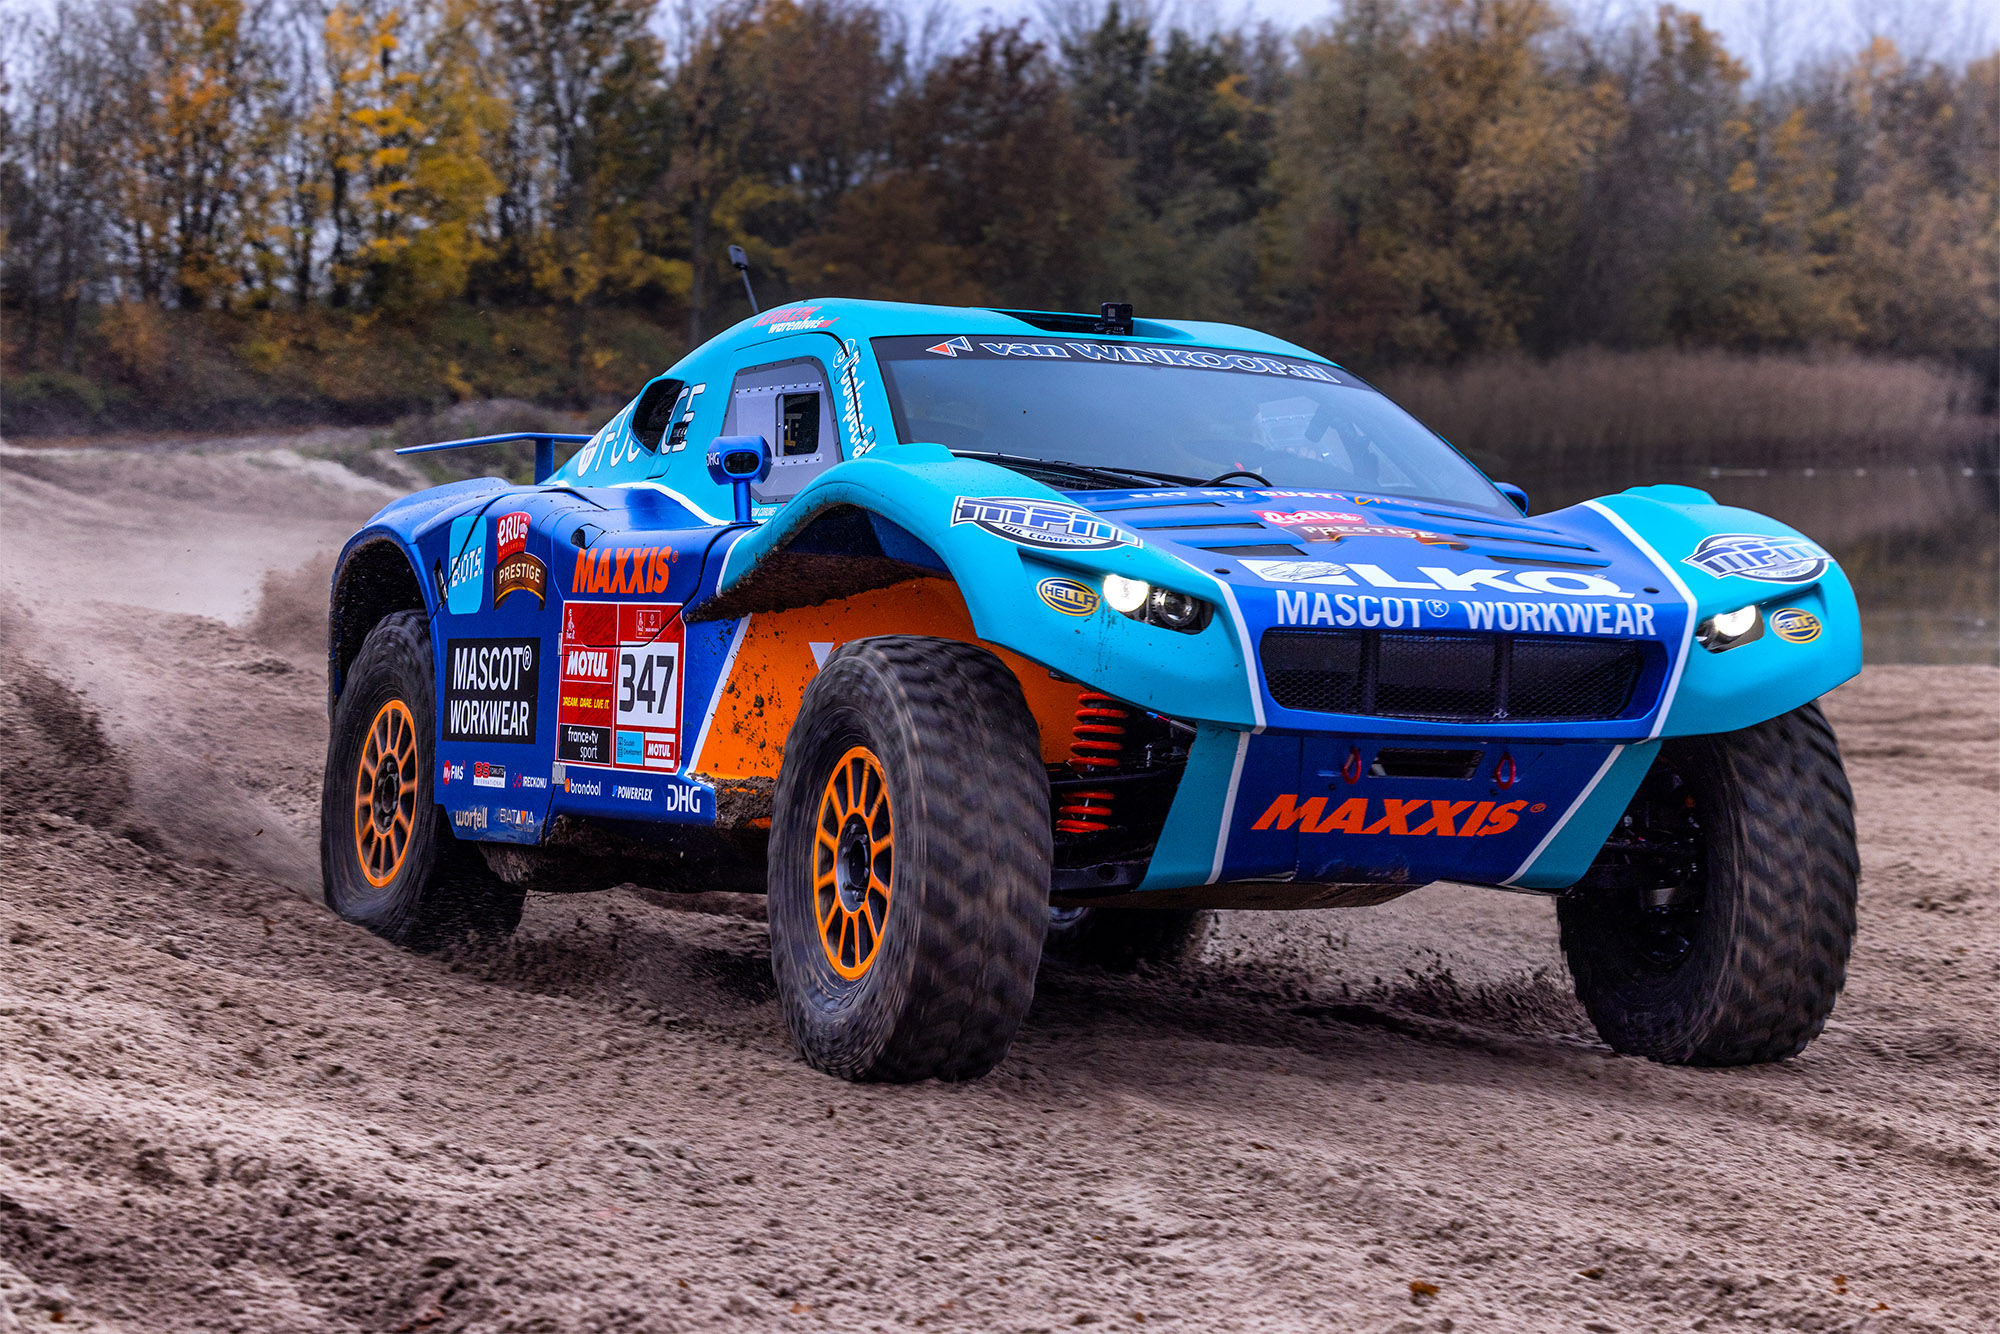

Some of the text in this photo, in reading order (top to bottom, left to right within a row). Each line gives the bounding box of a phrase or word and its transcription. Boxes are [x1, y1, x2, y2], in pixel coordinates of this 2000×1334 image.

[980, 342, 1071, 358] van
[1200, 490, 1245, 499] MY
[1002, 524, 1023, 536] OIL
[1029, 531, 1094, 546] COMPANY
[499, 563, 541, 585] PRESTIGE
[1044, 585, 1097, 607] HELLA
[1459, 600, 1657, 636] WORKWEAR
[566, 650, 608, 677] MOTUL
[619, 653, 675, 714] 347
[450, 699, 530, 736] WORKWEAR
[580, 745, 598, 762] sport
[647, 743, 671, 757] MOTUL
[666, 783, 702, 814] DHG
[455, 807, 488, 830] wortell
[500, 808, 535, 825] BATAVIA
